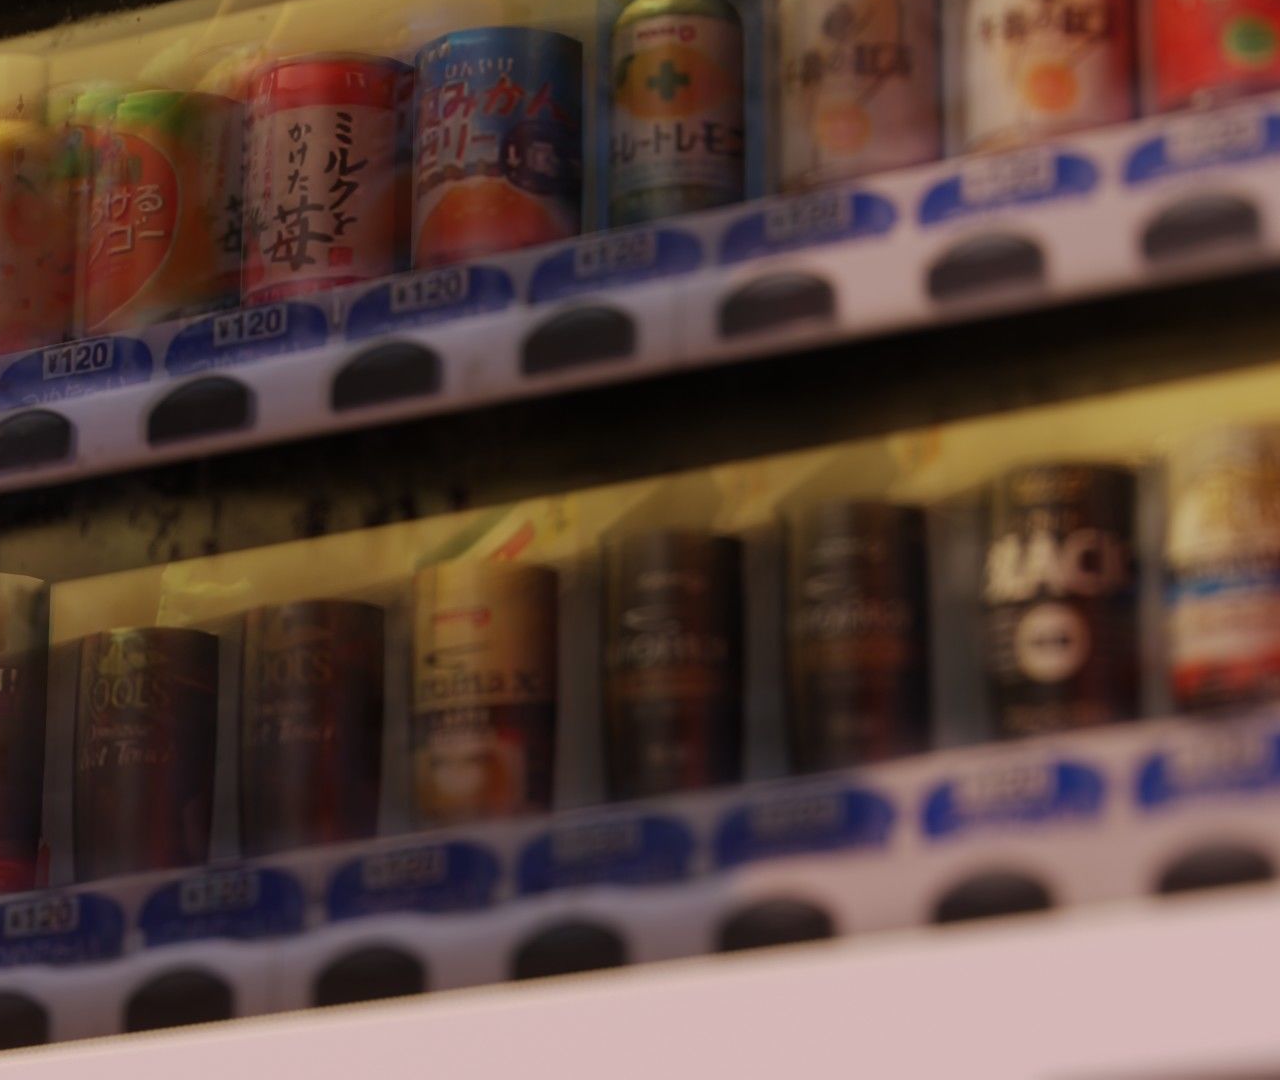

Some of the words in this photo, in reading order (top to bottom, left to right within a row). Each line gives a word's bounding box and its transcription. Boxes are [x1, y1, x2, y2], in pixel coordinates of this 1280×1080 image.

[263, 122, 335, 272] かけた苺
[220, 311, 283, 340] ¥120
[48, 342, 107, 374] ¥120
